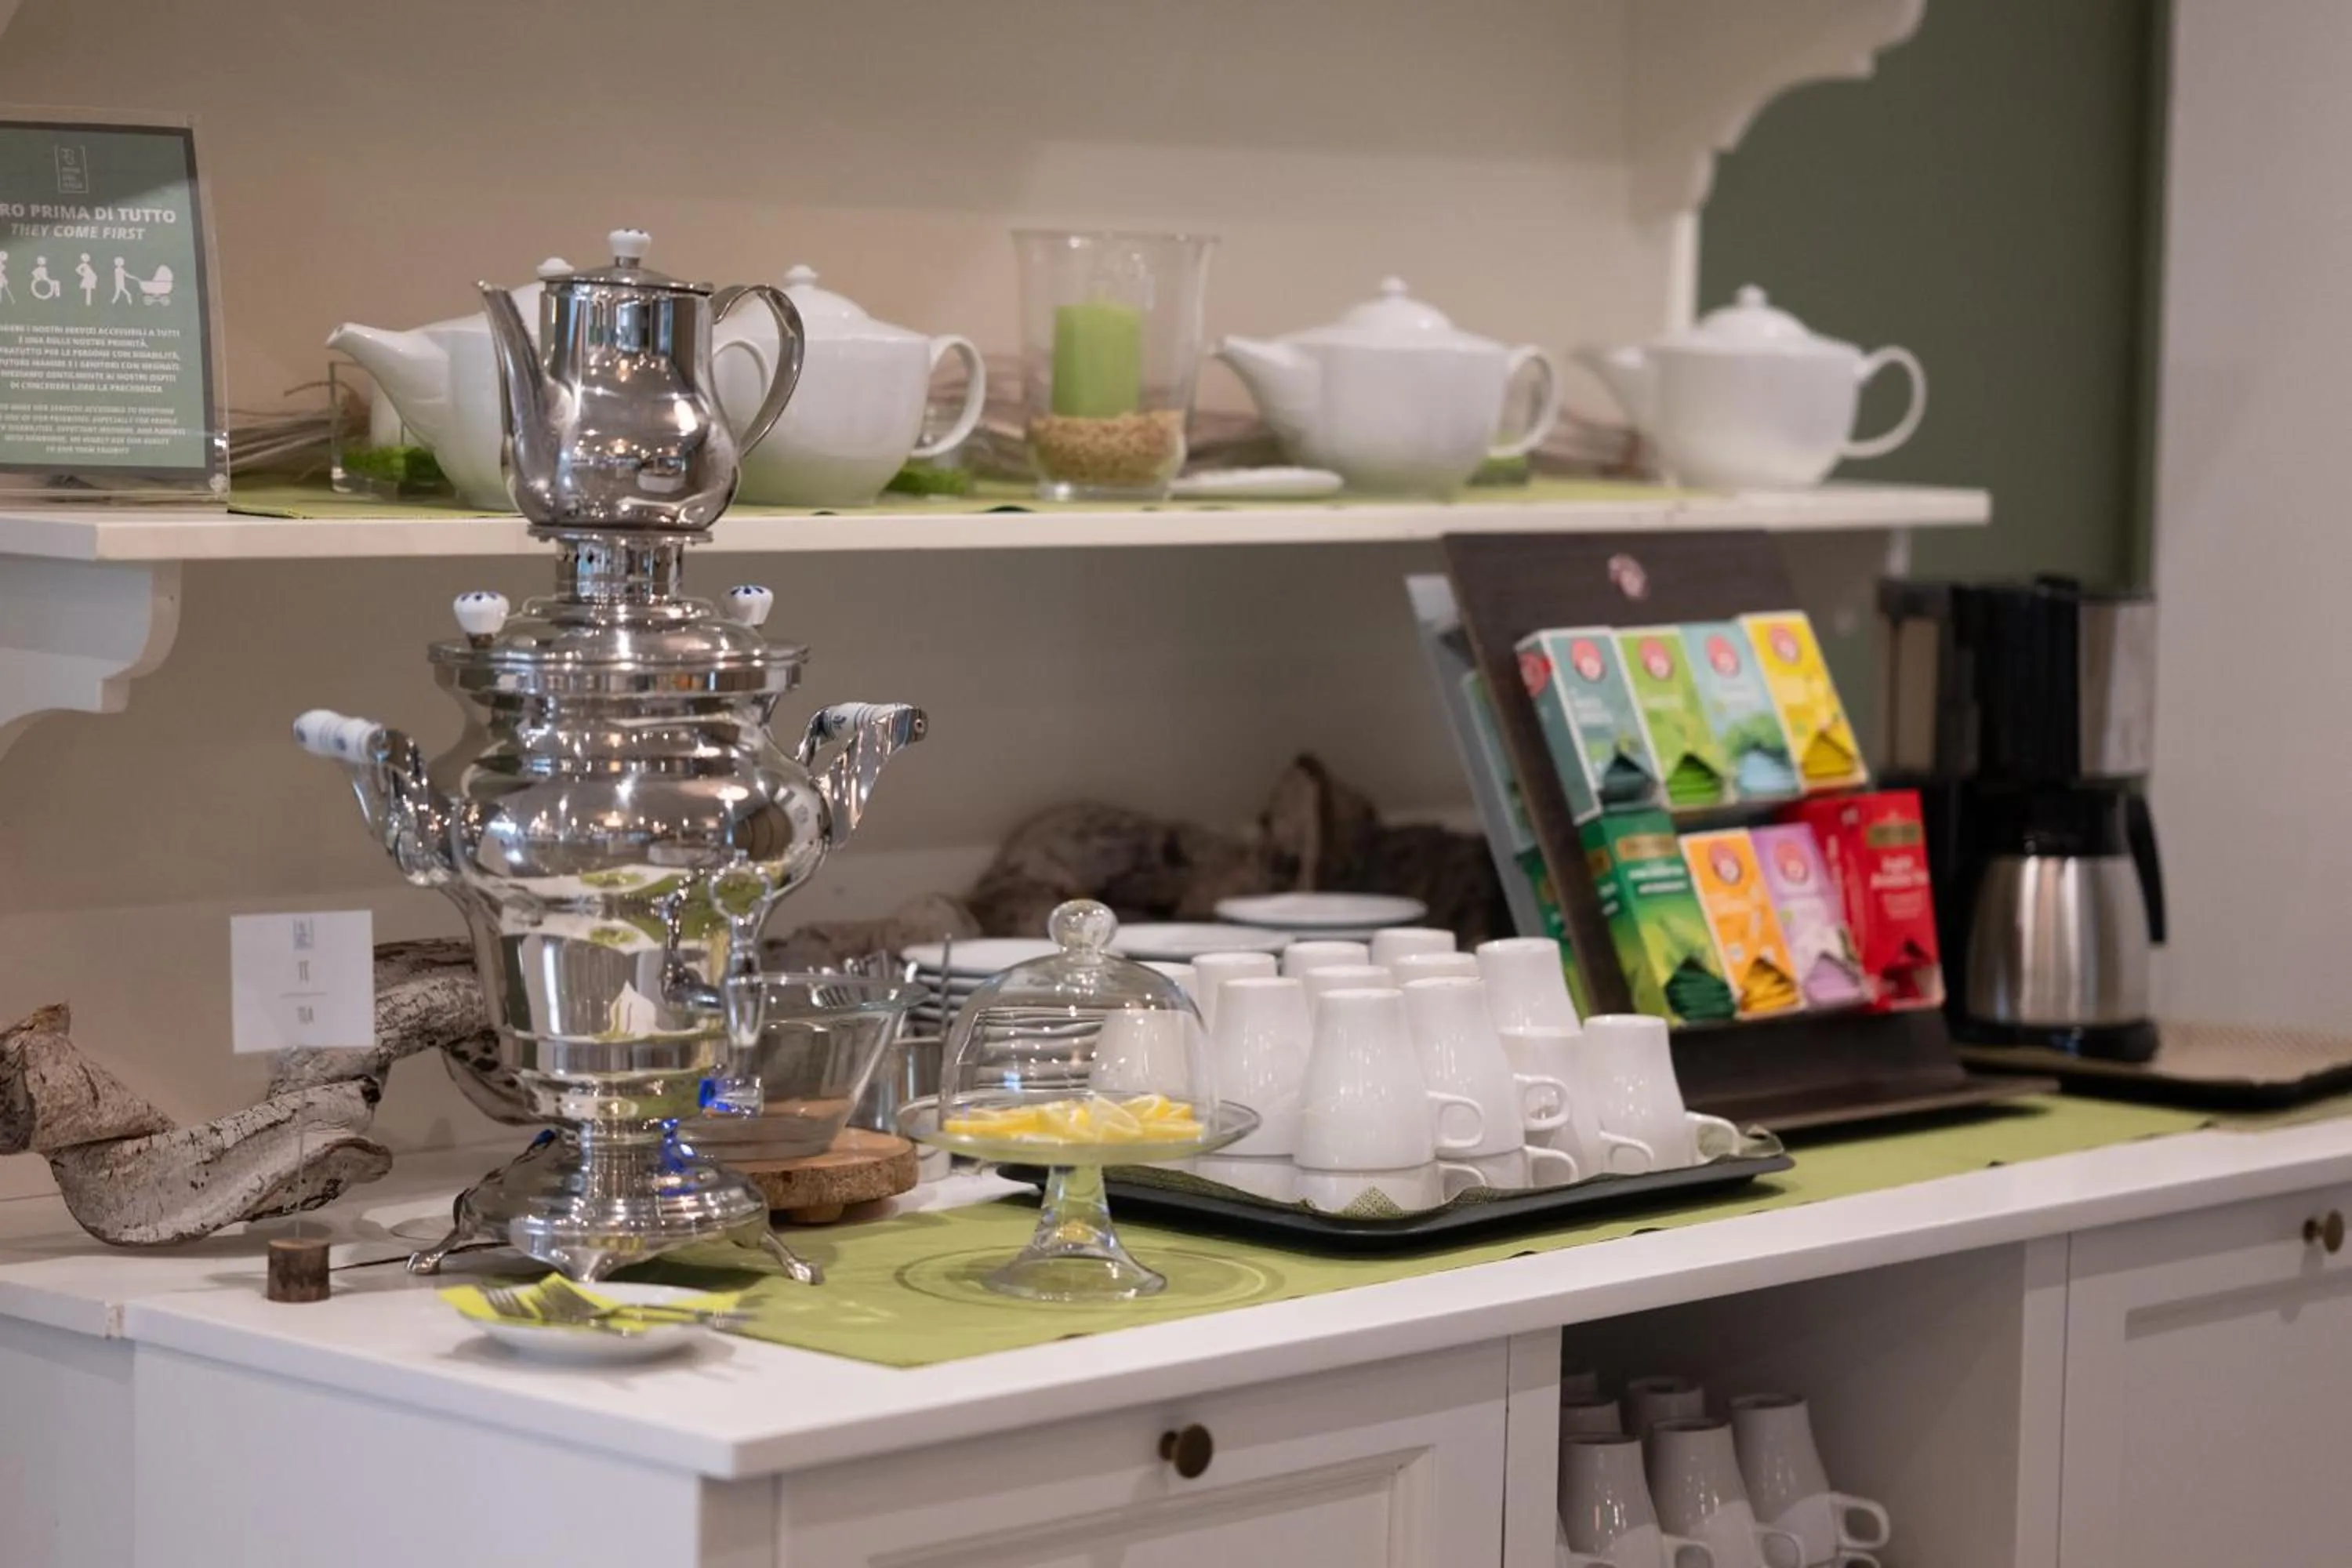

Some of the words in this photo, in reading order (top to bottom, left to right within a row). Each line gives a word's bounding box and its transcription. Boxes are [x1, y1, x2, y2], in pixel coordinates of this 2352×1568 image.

[30, 205, 90, 220] PRIMA
[95, 207, 113, 220] DI
[118, 208, 176, 223] TUTTO
[11, 223, 49, 238] THEY
[53, 225, 99, 238] COME
[102, 227, 146, 240] FIRST
